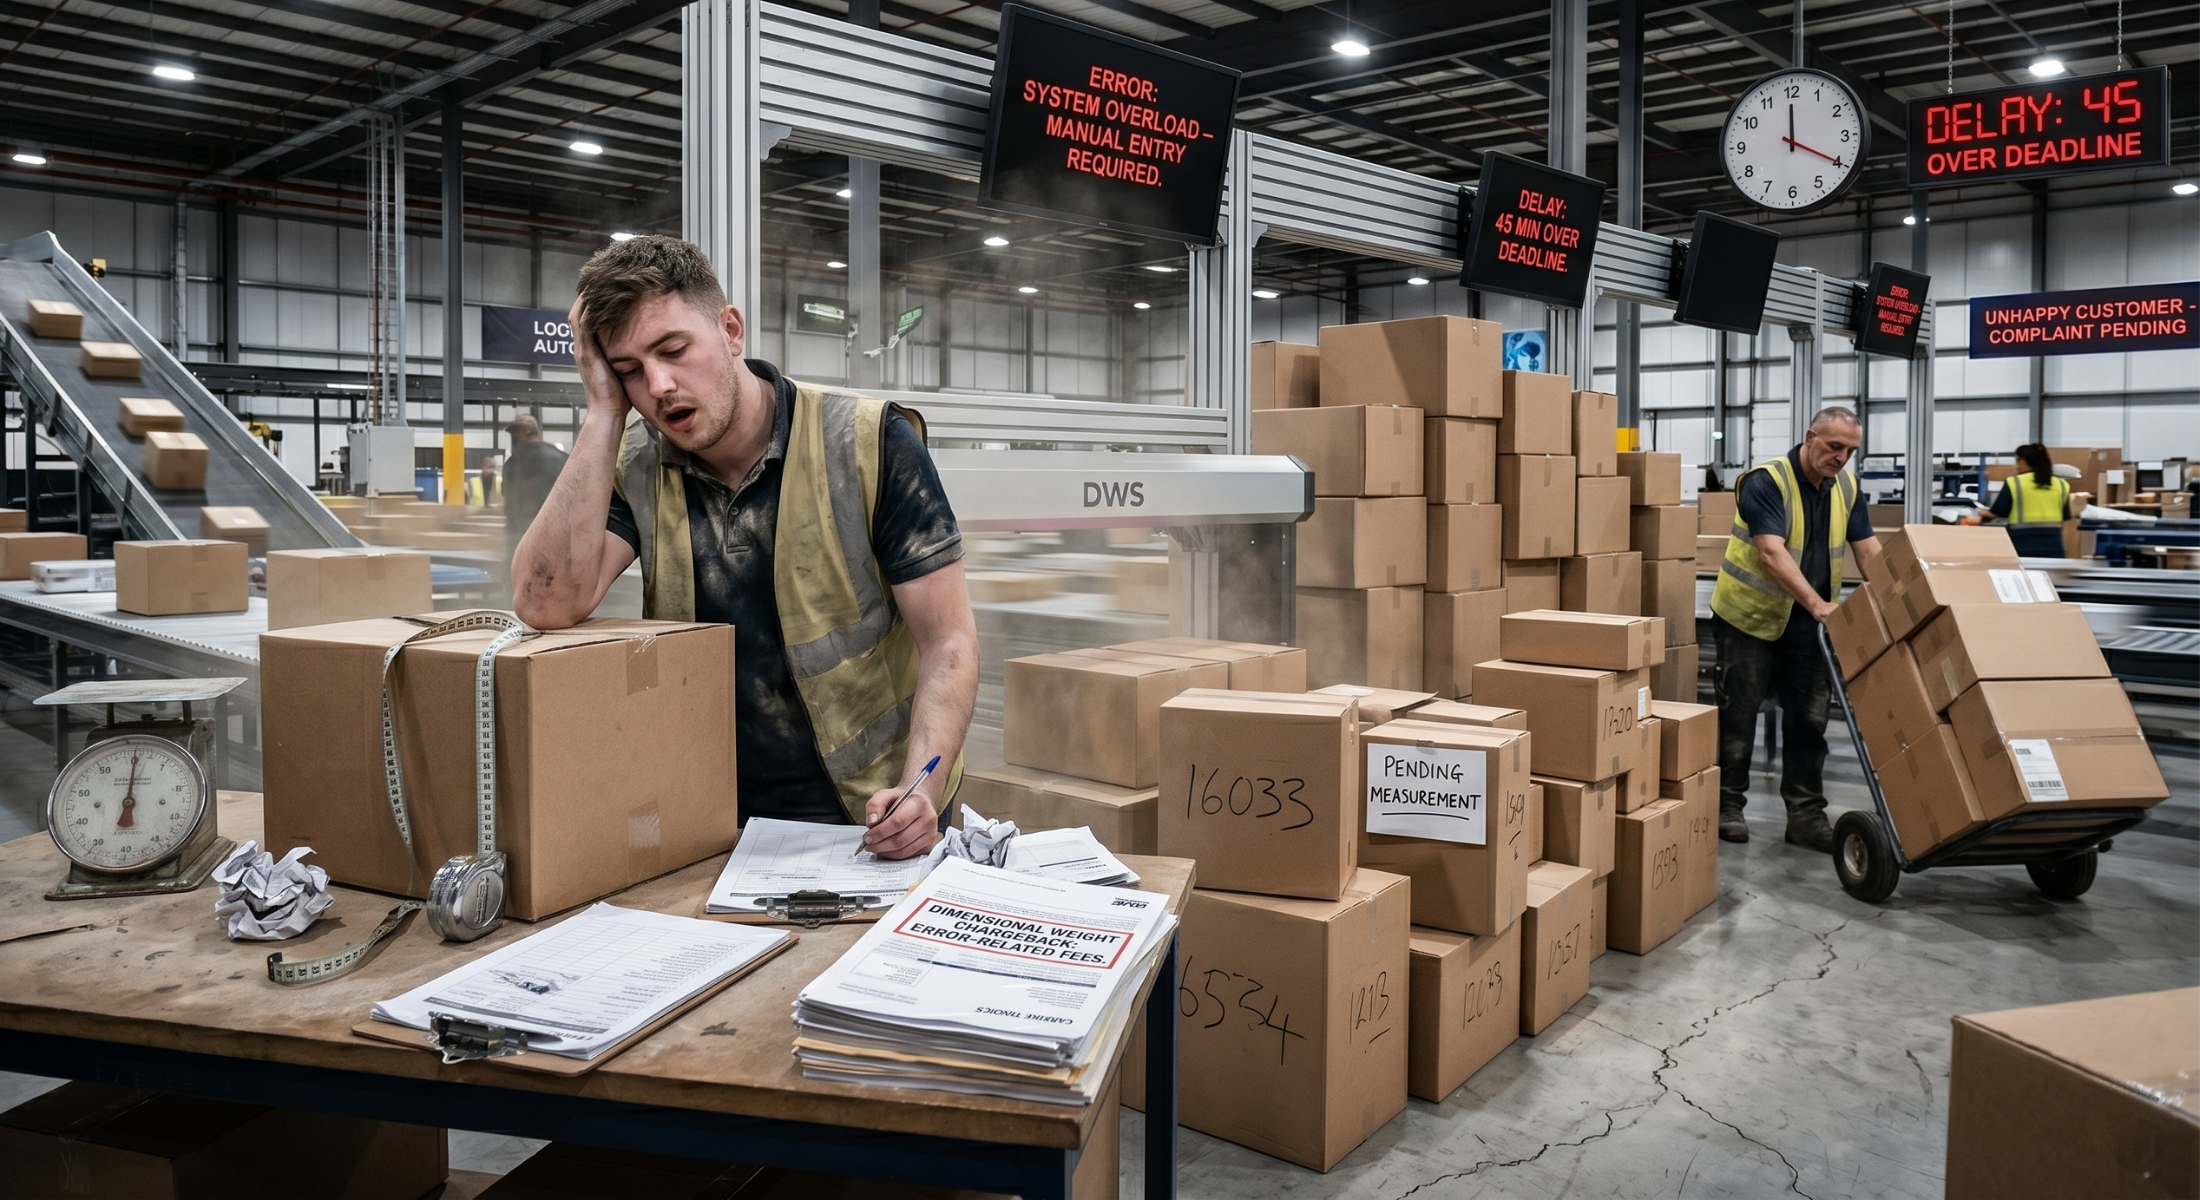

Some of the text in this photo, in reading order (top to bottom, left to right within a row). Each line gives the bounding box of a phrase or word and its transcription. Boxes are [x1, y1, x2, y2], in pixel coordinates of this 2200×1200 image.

[1089, 65, 1159, 103] ERROR:
[1784, 85, 1800, 99] 12
[1760, 96, 1773, 110] 11
[1813, 88, 1820, 102] 1
[1022, 79, 1101, 117] SYSTEM
[1104, 99, 1200, 140] OVERLOAD
[1832, 104, 1842, 118] 2
[1927, 80, 2141, 145] DELAY: 45
[1742, 116, 1758, 130] 10
[1045, 114, 1187, 164] MANUAL ENTRY
[1840, 129, 1850, 143] 3
[1736, 141, 1746, 155] 9
[1926, 131, 2142, 175] OVER DEADLINE
[1066, 147, 1163, 187] REQUIRED.
[1744, 164, 1754, 178] 8
[1832, 155, 1843, 169] 4
[1763, 180, 1773, 194] 7
[1813, 175, 1823, 189] 5
[1788, 185, 1797, 199] 6
[1518, 189, 1567, 220] DELAY:
[1495, 212, 1580, 249] 45 MIN OVER
[1498, 240, 1568, 273] DEADLINE.
[1985, 305, 2071, 325] UNHAPPY
[2075, 298, 2183, 320] CUSTOMER
[1989, 318, 2187, 344] COMPLAINT PENDING
[1083, 481, 1144, 507] DWS
[99, 766, 111, 774] 50
[1384, 755, 1464, 783] PENDING
[78, 789, 90, 797] 50
[1186, 763, 1314, 831] 16033
[1370, 786, 1482, 810] MEASUREMENT
[76, 818, 88, 826] 40
[92, 838, 104, 846] 30
[927, 904, 1045, 935] DIMENSIONAL
[1050, 927, 1121, 945] WEIGHT
[953, 920, 1079, 949] CHARGEBACK:
[1059, 950, 1106, 965] FEES.
